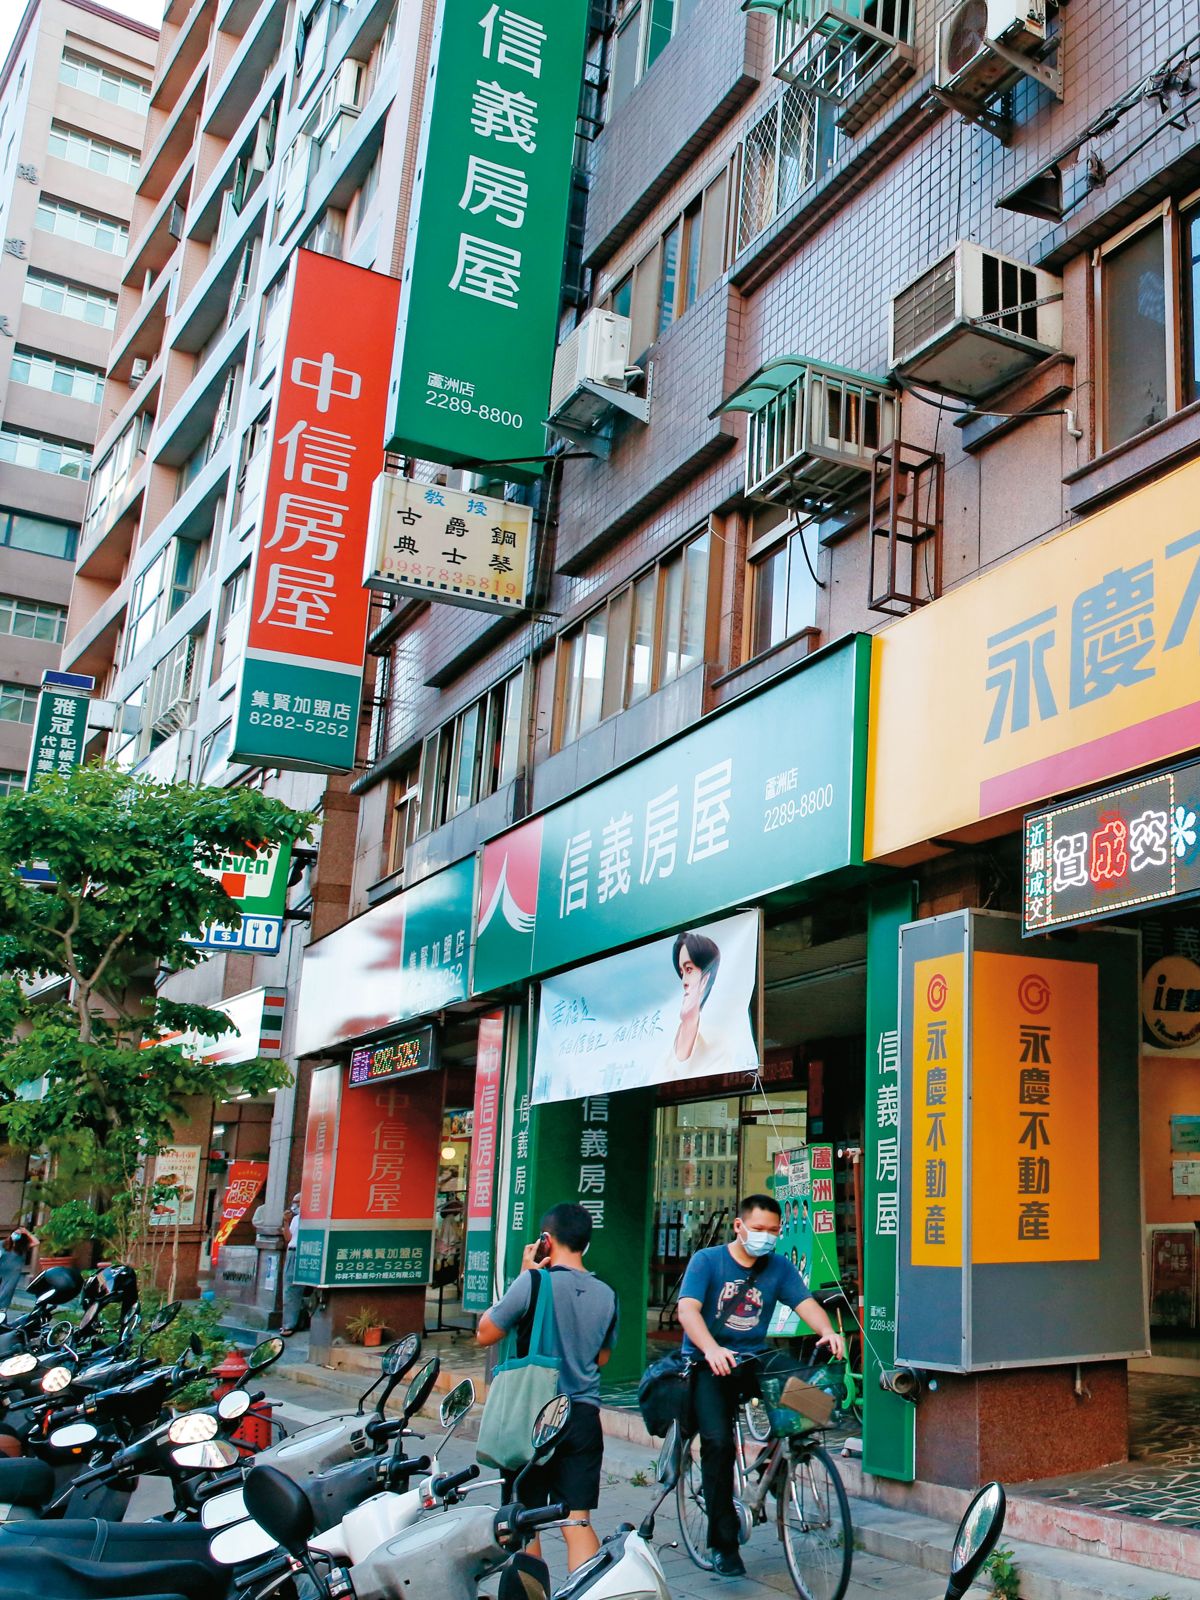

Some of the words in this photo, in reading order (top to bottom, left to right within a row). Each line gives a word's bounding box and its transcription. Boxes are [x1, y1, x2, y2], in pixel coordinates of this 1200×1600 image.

[448, 3, 547, 310] 信義房屋
[425, 390, 524, 430] 2289-8800
[427, 372, 475, 399] 蘆洲店
[257, 351, 362, 636] 中信房屋
[424, 488, 488, 517] 教授
[393, 506, 423, 556] 古典
[441, 516, 469, 566] 爵士
[488, 526, 517, 575] 鋼琴
[382, 557, 517, 596] 0987835819
[49, 697, 78, 736] 雅冠
[248, 710, 350, 739] 8282-5252
[251, 688, 352, 723] 集賢加盟店
[763, 783, 834, 834] 2289-8800
[764, 767, 799, 802] 蘆洲店
[558, 757, 734, 920] 信義房屋
[1053, 810, 1168, 893] 賀成交
[1029, 822, 1046, 922] 近期成交
[366, 1088, 410, 1213] 中信房屋
[473, 1044, 500, 1208] 中信房屋
[875, 1030, 898, 1236] 信義房屋
[925, 1020, 948, 1245] 永慶不動產
[1018, 1024, 1051, 1241] 永慶不動產
[511, 1094, 532, 1232] 信義房屋
[811, 1146, 835, 1235] 蘆洲店
[335, 1247, 424, 1260] 蘆洲集賢加盟店
[335, 1260, 423, 1272] 8282-5252
[722, 1281, 763, 1307] BLCK
